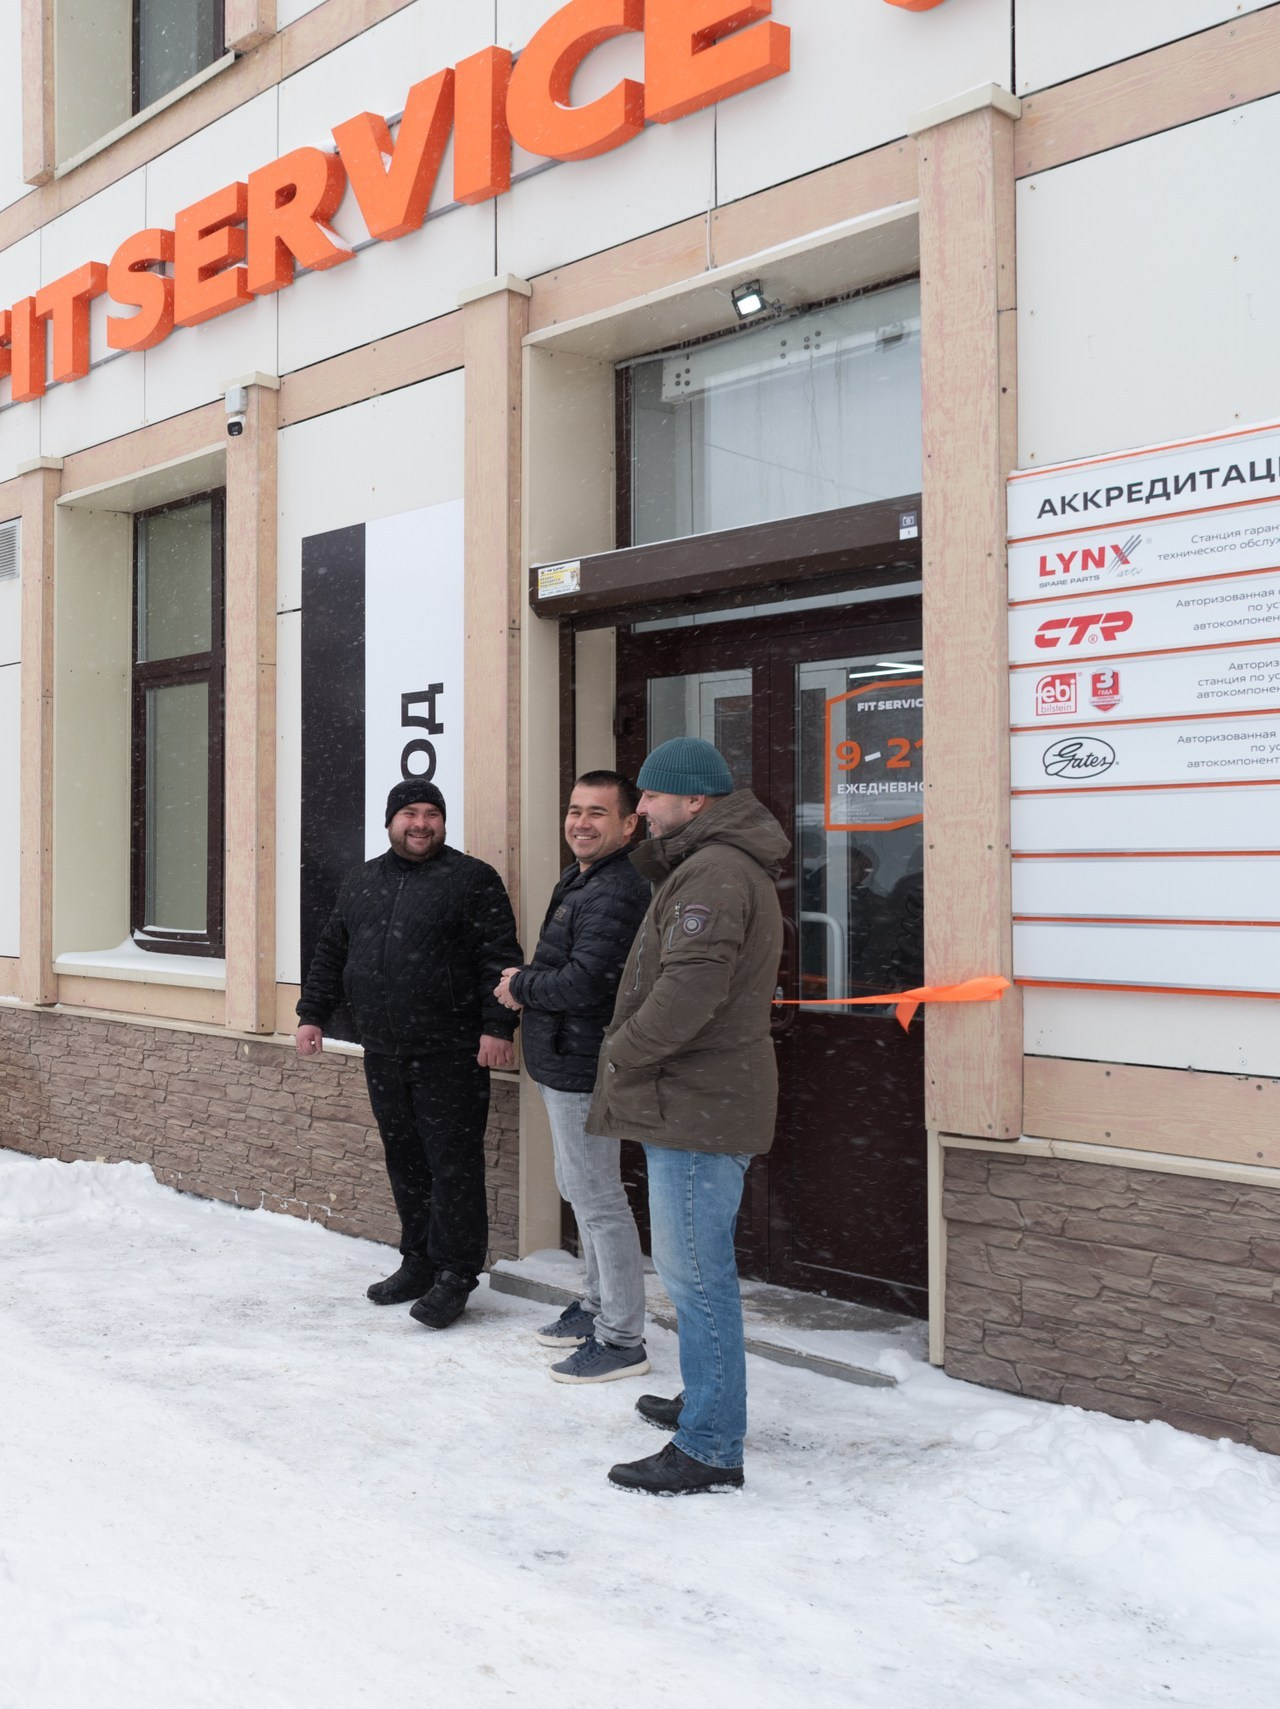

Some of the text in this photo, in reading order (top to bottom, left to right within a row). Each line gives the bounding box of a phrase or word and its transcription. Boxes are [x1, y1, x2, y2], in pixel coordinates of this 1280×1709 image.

[1037, 455, 1280, 519] АККРЕДИТАЦ
[1191, 524, 1280, 544] Станция гаран
[1039, 536, 1141, 577] LYNX
[1158, 543, 1237, 561] технического
[1039, 574, 1100, 589] SPARE PARTS
[1175, 589, 1275, 609] Авторизованная
[1248, 601, 1280, 612] по ус
[1034, 610, 1133, 649] CTR
[1228, 660, 1280, 671] Авториз
[1095, 667, 1114, 689] 3
[1198, 675, 1246, 687] станция
[1250, 674, 1265, 682] по
[1036, 676, 1076, 704] febi
[1041, 704, 1072, 713] bilstein
[1177, 731, 1276, 744] Авторизованная
[1250, 744, 1266, 752] по
[1046, 742, 1114, 776] Gates
